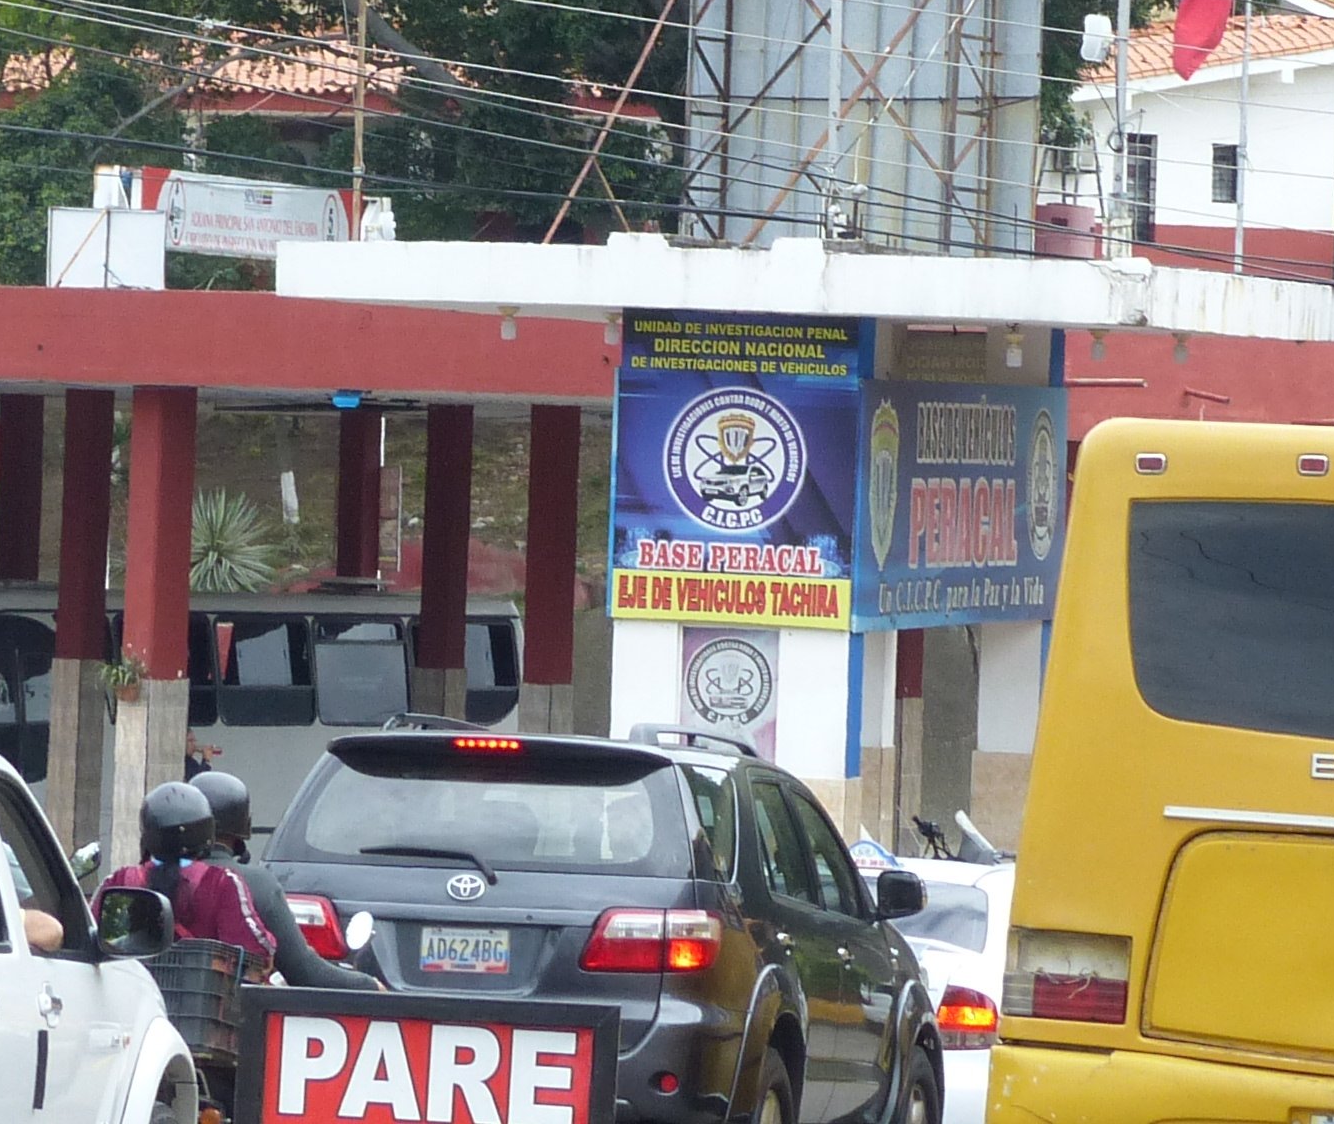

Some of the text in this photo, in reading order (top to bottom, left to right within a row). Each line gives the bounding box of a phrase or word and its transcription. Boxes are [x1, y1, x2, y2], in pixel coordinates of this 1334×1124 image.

[634, 320, 848, 340] UNIDAD DE INVESTIGACION PENAL
[654, 338, 825, 358] DIRECCION NACIONAL
[631, 356, 847, 376] DE INVESTIGACIONES DE VEHICULOS
[917, 402, 945, 464] BASE
[908, 477, 1017, 569] PERACAL
[639, 541, 821, 574] BASE PERACAL
[618, 575, 838, 618] EJE DE VEHICULOS TACHIRA
[879, 584, 892, 614] Un
[946, 586, 968, 614] para
[971, 578, 981, 607] la
[983, 578, 999, 606] Paz
[1001, 584, 1009, 610] y
[1010, 577, 1020, 606] la
[1023, 576, 1044, 605] Vida
[427, 938, 503, 962] AD624BG
[277, 1014, 577, 1124] PARE
